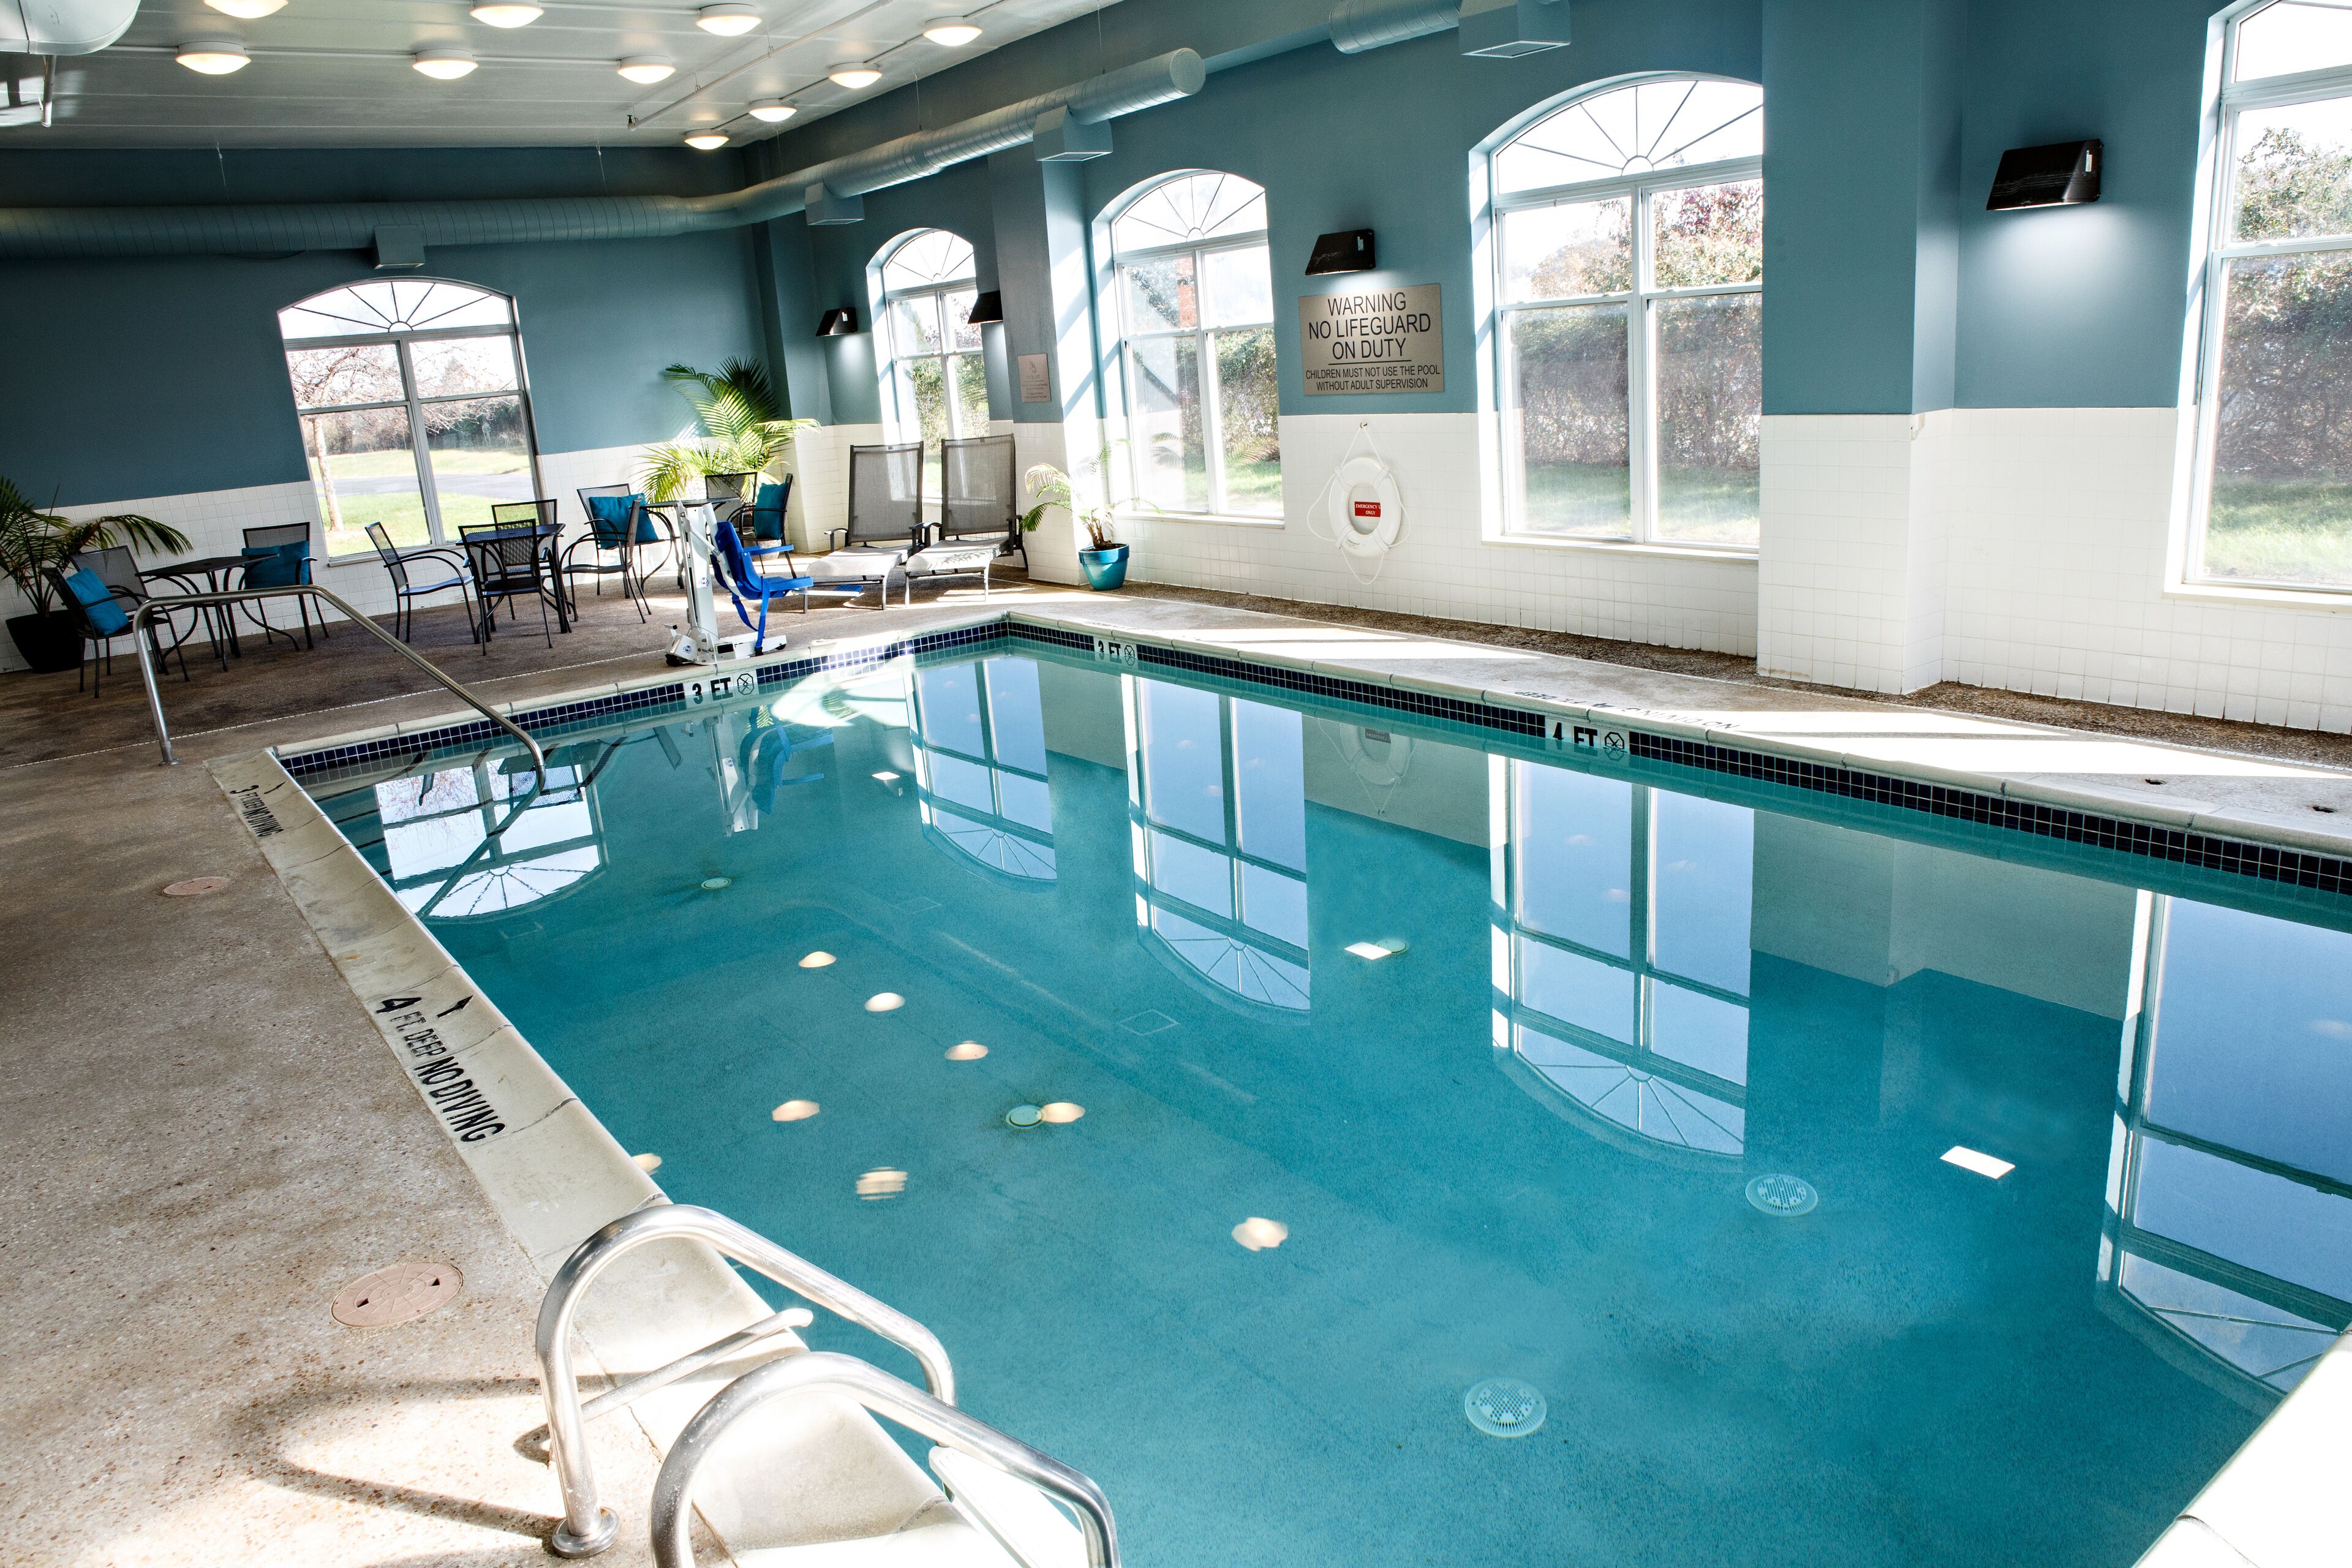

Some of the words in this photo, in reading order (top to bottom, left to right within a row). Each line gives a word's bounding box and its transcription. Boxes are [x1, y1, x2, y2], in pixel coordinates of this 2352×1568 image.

[1328, 292, 1406, 316] WARNING
[1309, 321, 1331, 339] NO
[1336, 314, 1431, 337] LIFEGUARD
[1333, 341, 1355, 360] ON
[1361, 337, 1406, 358] DUTY
[1306, 368, 1341, 379] CHILDREN
[1343, 368, 1363, 378] MUST
[1365, 368, 1381, 377] NOT
[1382, 367, 1398, 377] USE
[1400, 366, 1415, 376] THE
[1417, 364, 1440, 375] POOL
[1316, 381, 1349, 391] WITHOUT
[1351, 380, 1373, 390] ADULT
[1376, 378, 1428, 389] SUPERVISION
[1108, 642, 1121, 656] FT
[1621, 707, 1703, 723] DIVING
[1553, 722, 1564, 741] 4
[1574, 726, 1598, 747] FT
[230, 785, 260, 794] 3
[242, 797, 265, 809] DEEP
[242, 806, 271, 820] NO
[247, 815, 284, 837] DIVING
[376, 997, 422, 1014] 4
[404, 1028, 447, 1057] DEEP
[413, 1056, 464, 1085] NO
[429, 1079, 506, 1142] DIVING
